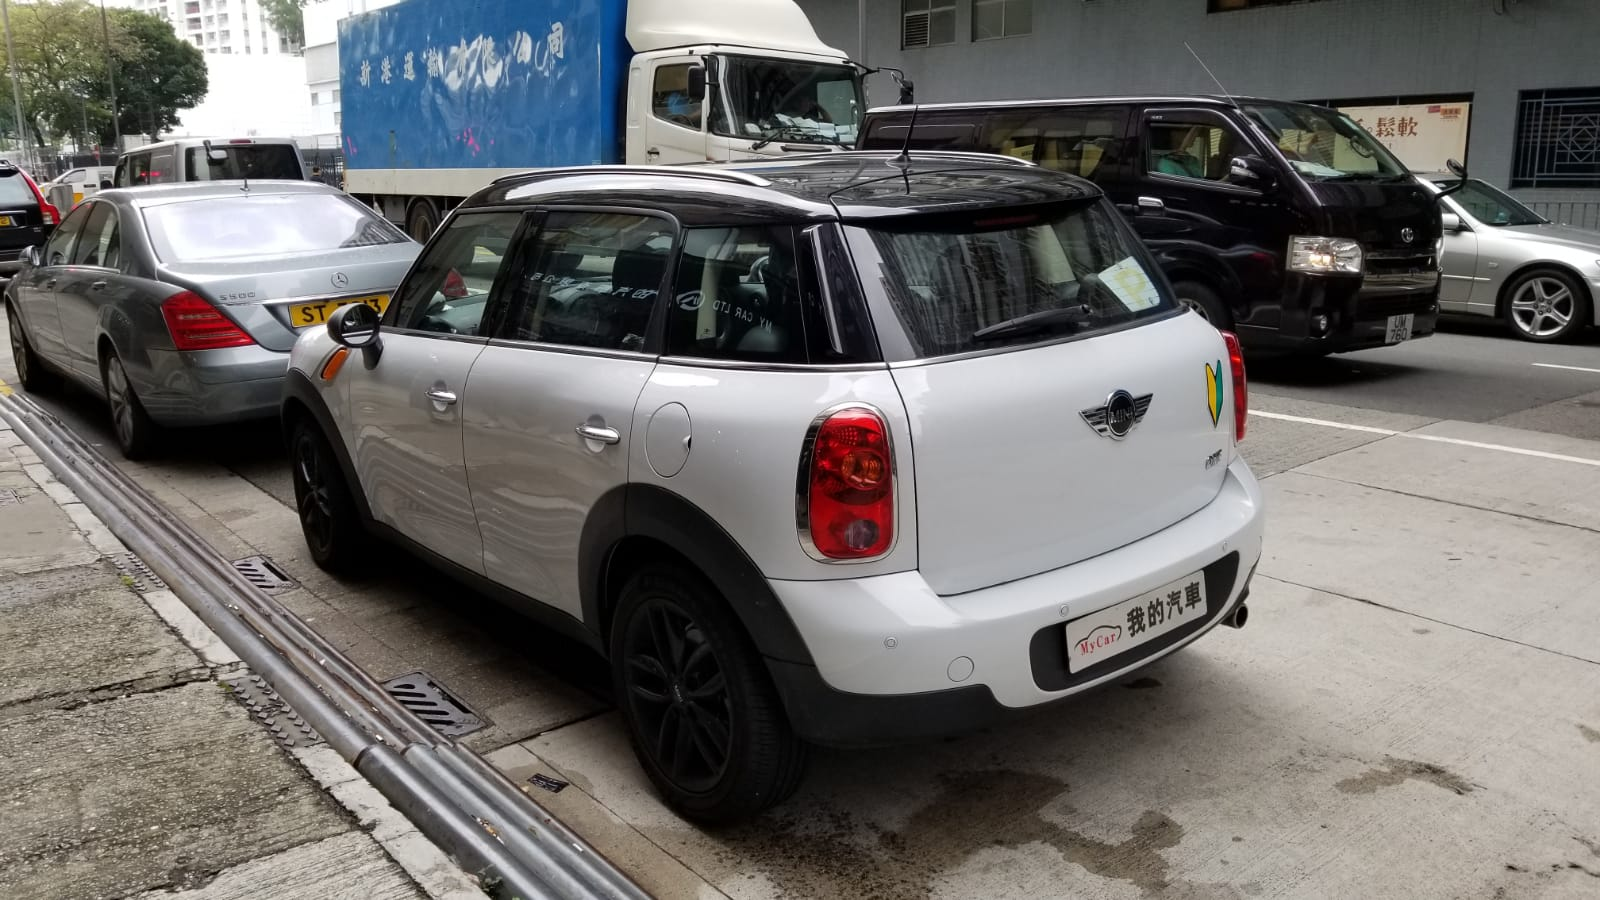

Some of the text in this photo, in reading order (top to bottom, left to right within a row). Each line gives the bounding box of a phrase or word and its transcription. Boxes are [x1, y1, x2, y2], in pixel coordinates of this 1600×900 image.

[219, 291, 256, 300] S500
[302, 305, 326, 323] ST
[1126, 581, 1202, 638] 我的汽車
[1080, 633, 1117, 656] MyCar
